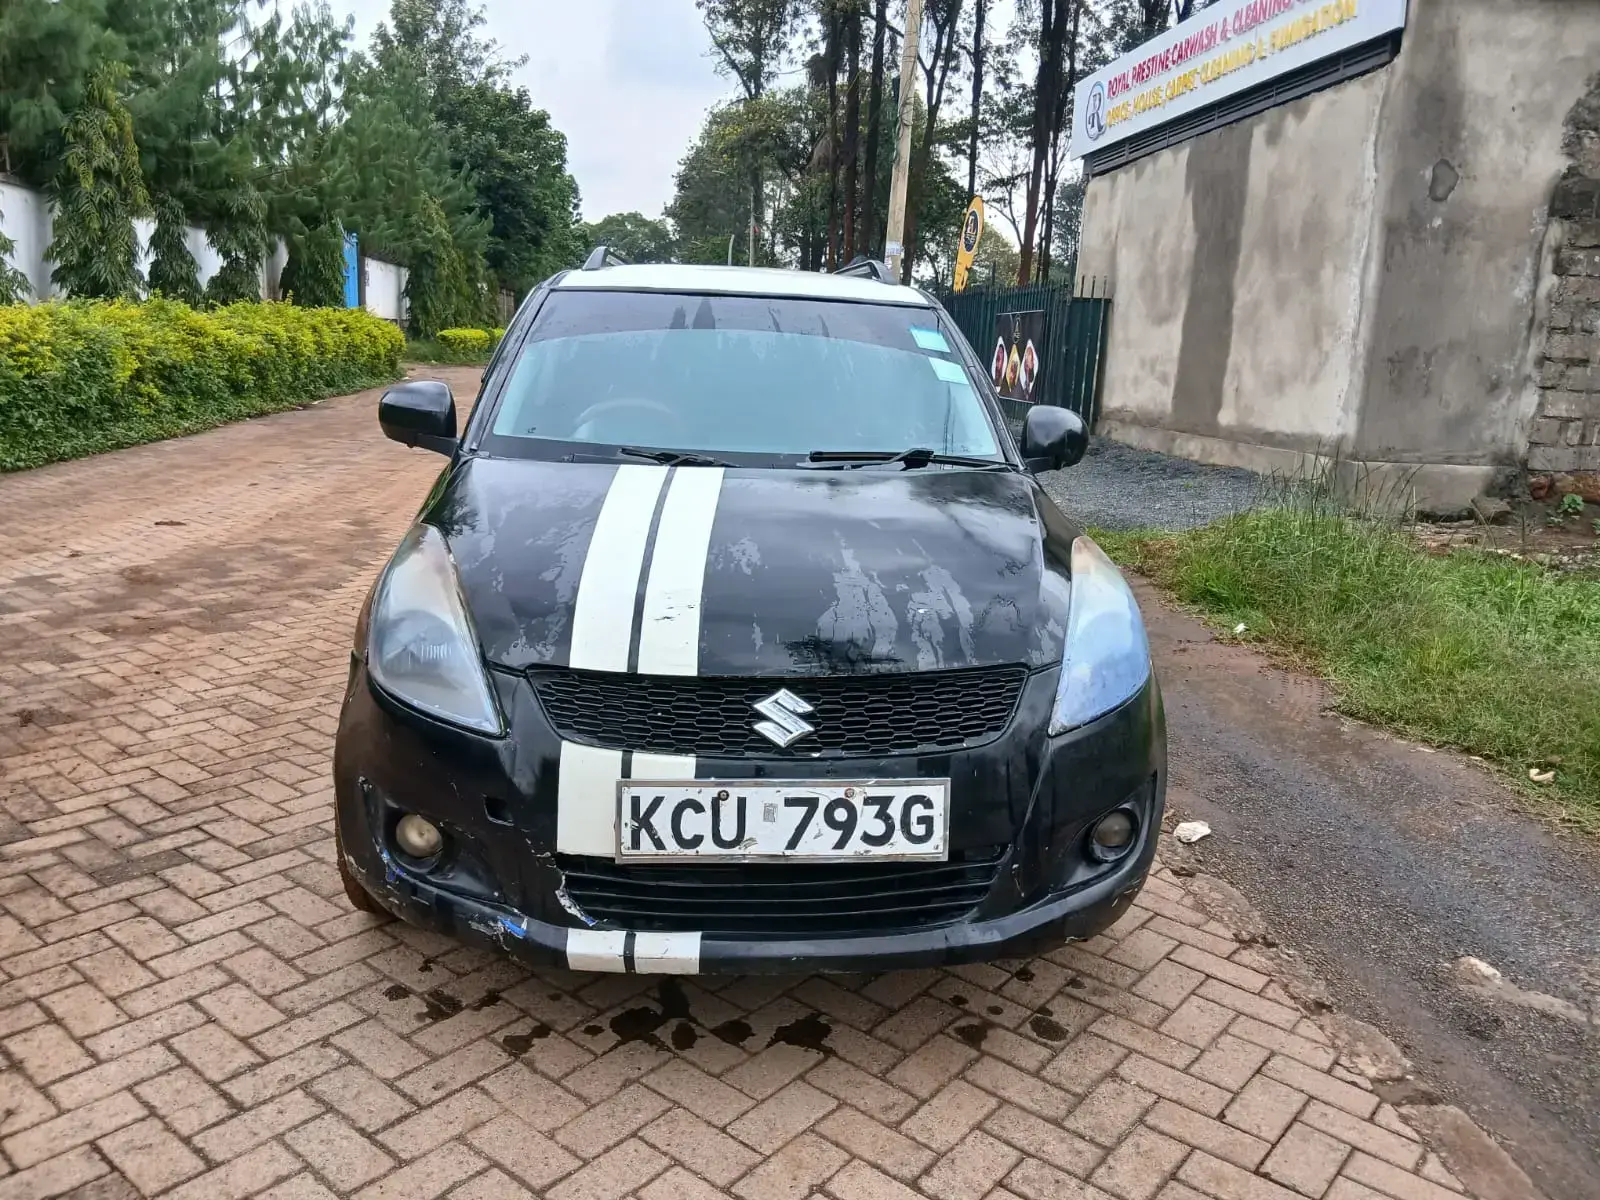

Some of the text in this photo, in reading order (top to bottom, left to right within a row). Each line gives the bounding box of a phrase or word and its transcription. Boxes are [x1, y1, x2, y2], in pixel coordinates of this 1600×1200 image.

[1107, 72, 1130, 98] ROYAL
[1132, 51, 1170, 87] PRESTINE
[1171, 23, 1217, 68] CARWASH
[1220, 16, 1230, 39] &
[629, 793, 935, 850] KCU 793G
